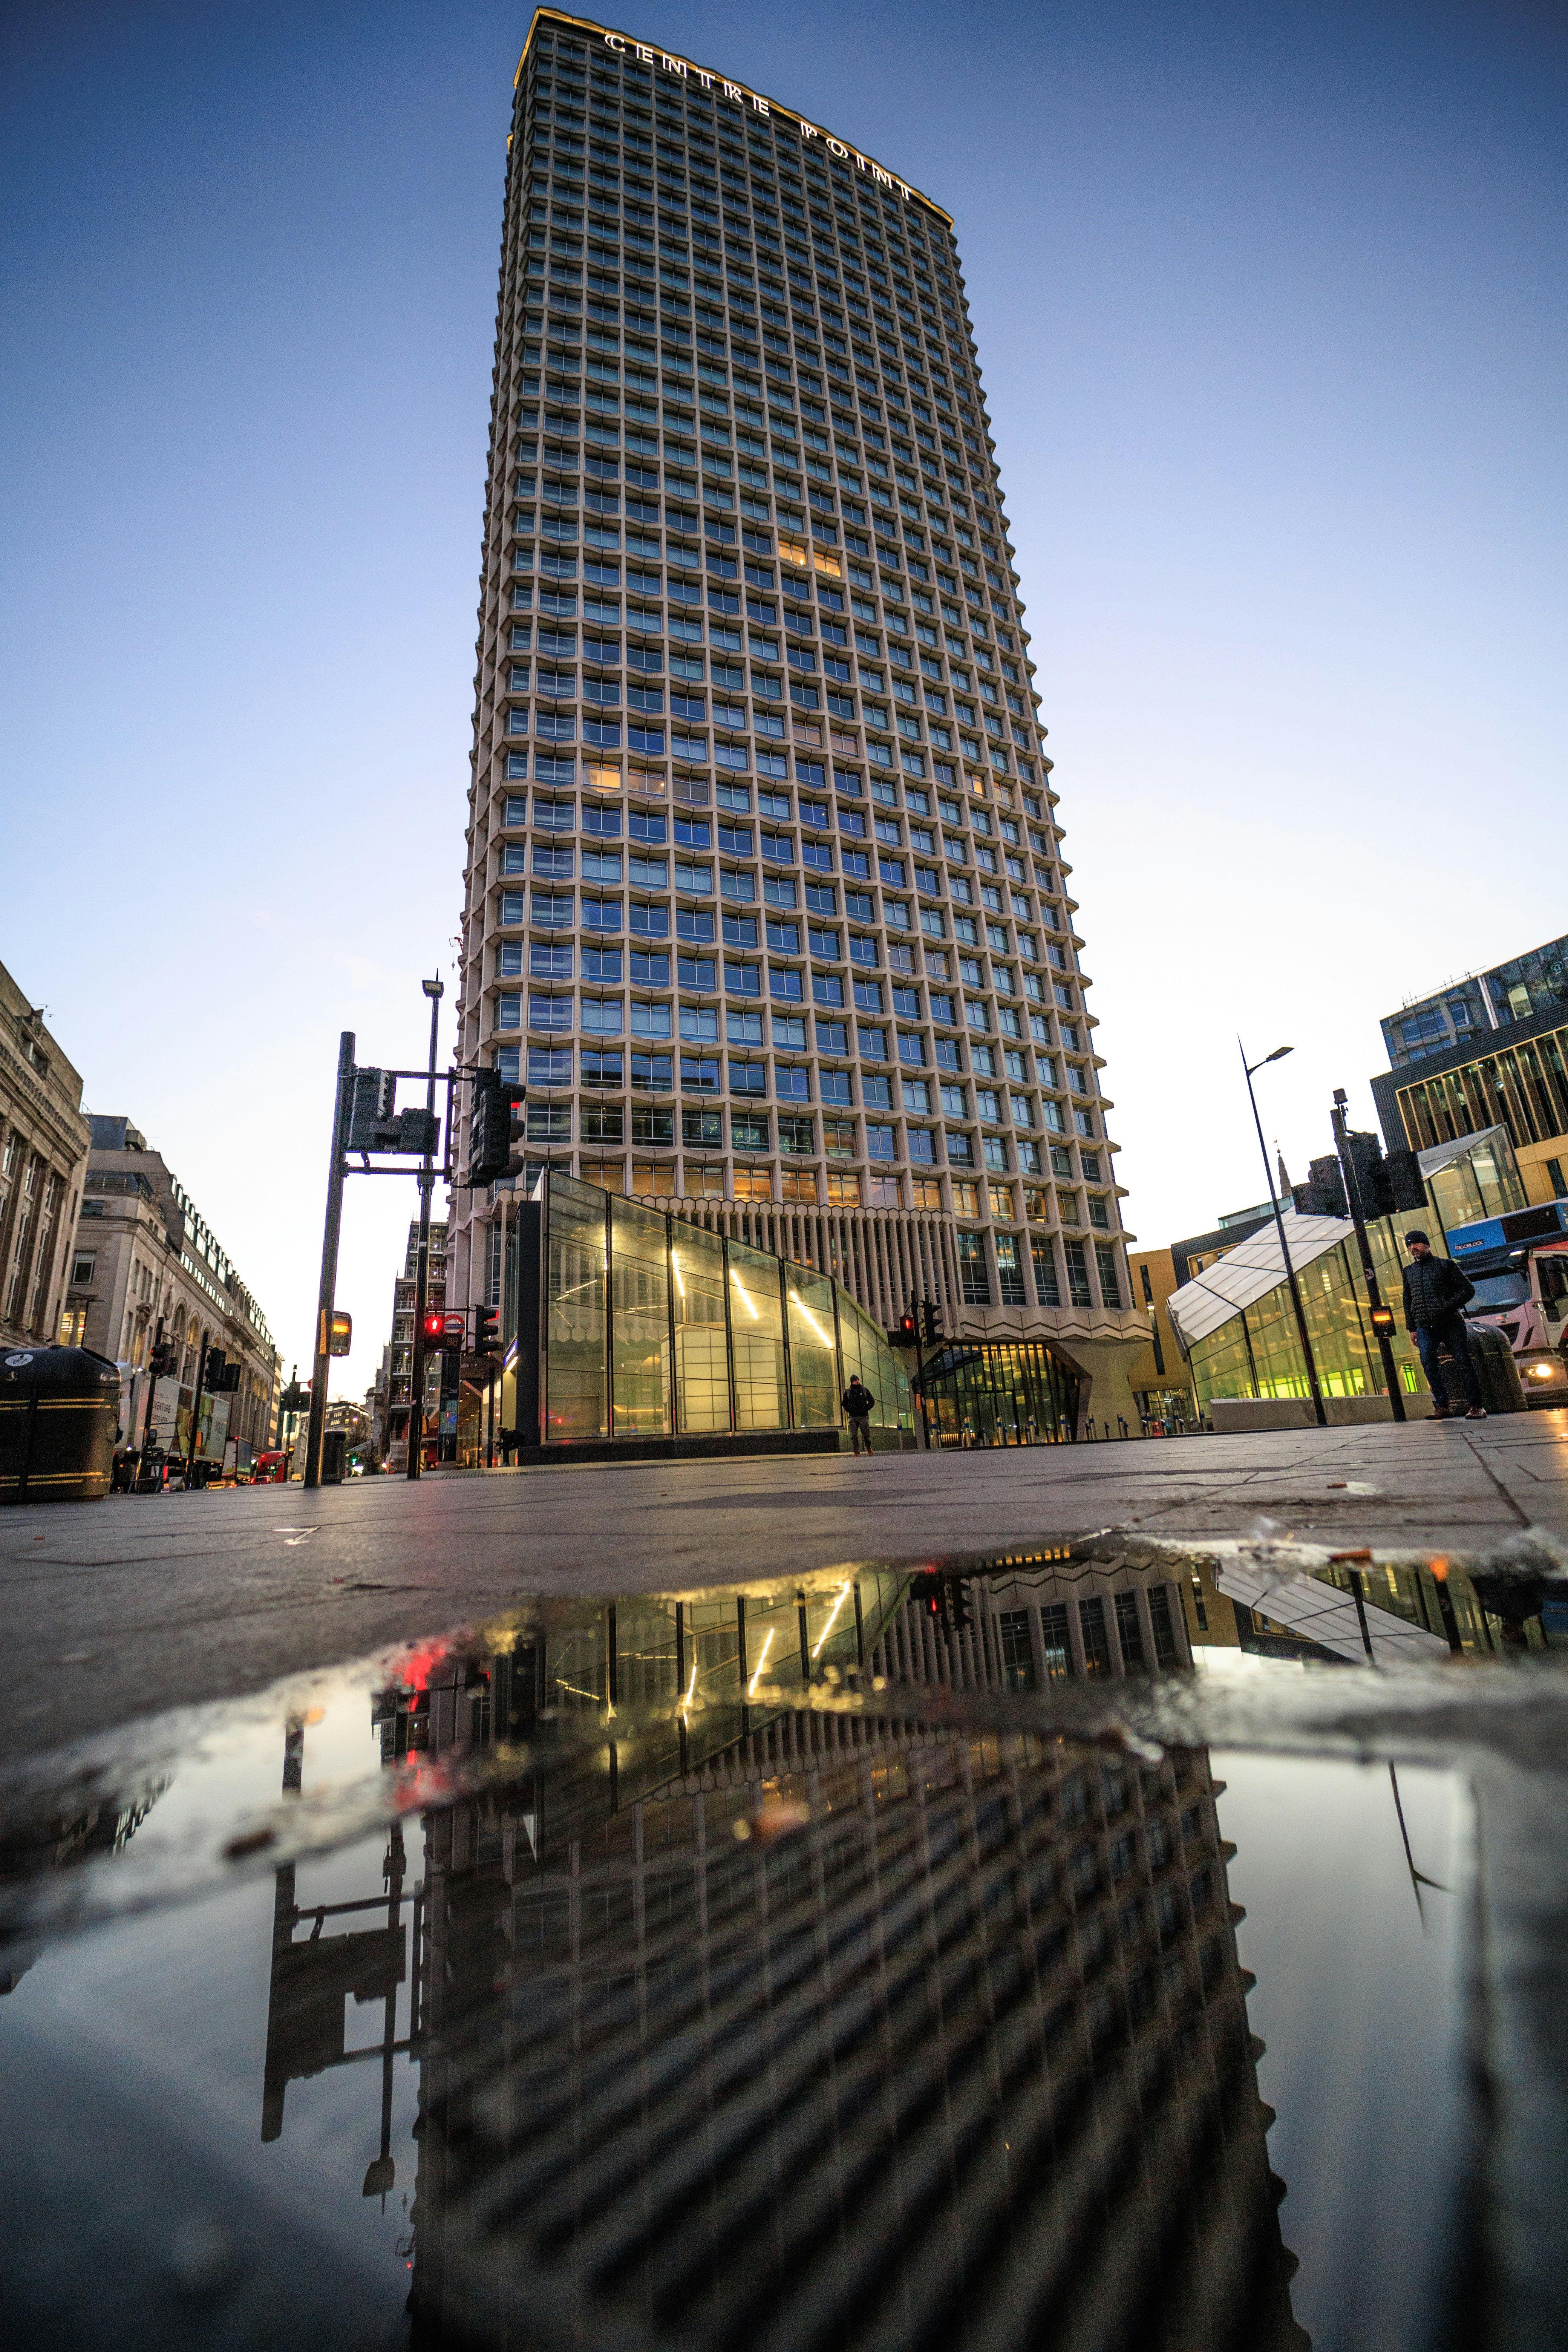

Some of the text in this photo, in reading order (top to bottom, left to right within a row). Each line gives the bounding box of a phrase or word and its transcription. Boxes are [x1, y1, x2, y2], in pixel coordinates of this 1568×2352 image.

[605, 34, 912, 201] CENTRE POINT
[152, 1400, 171, 1413] DVENTURE
